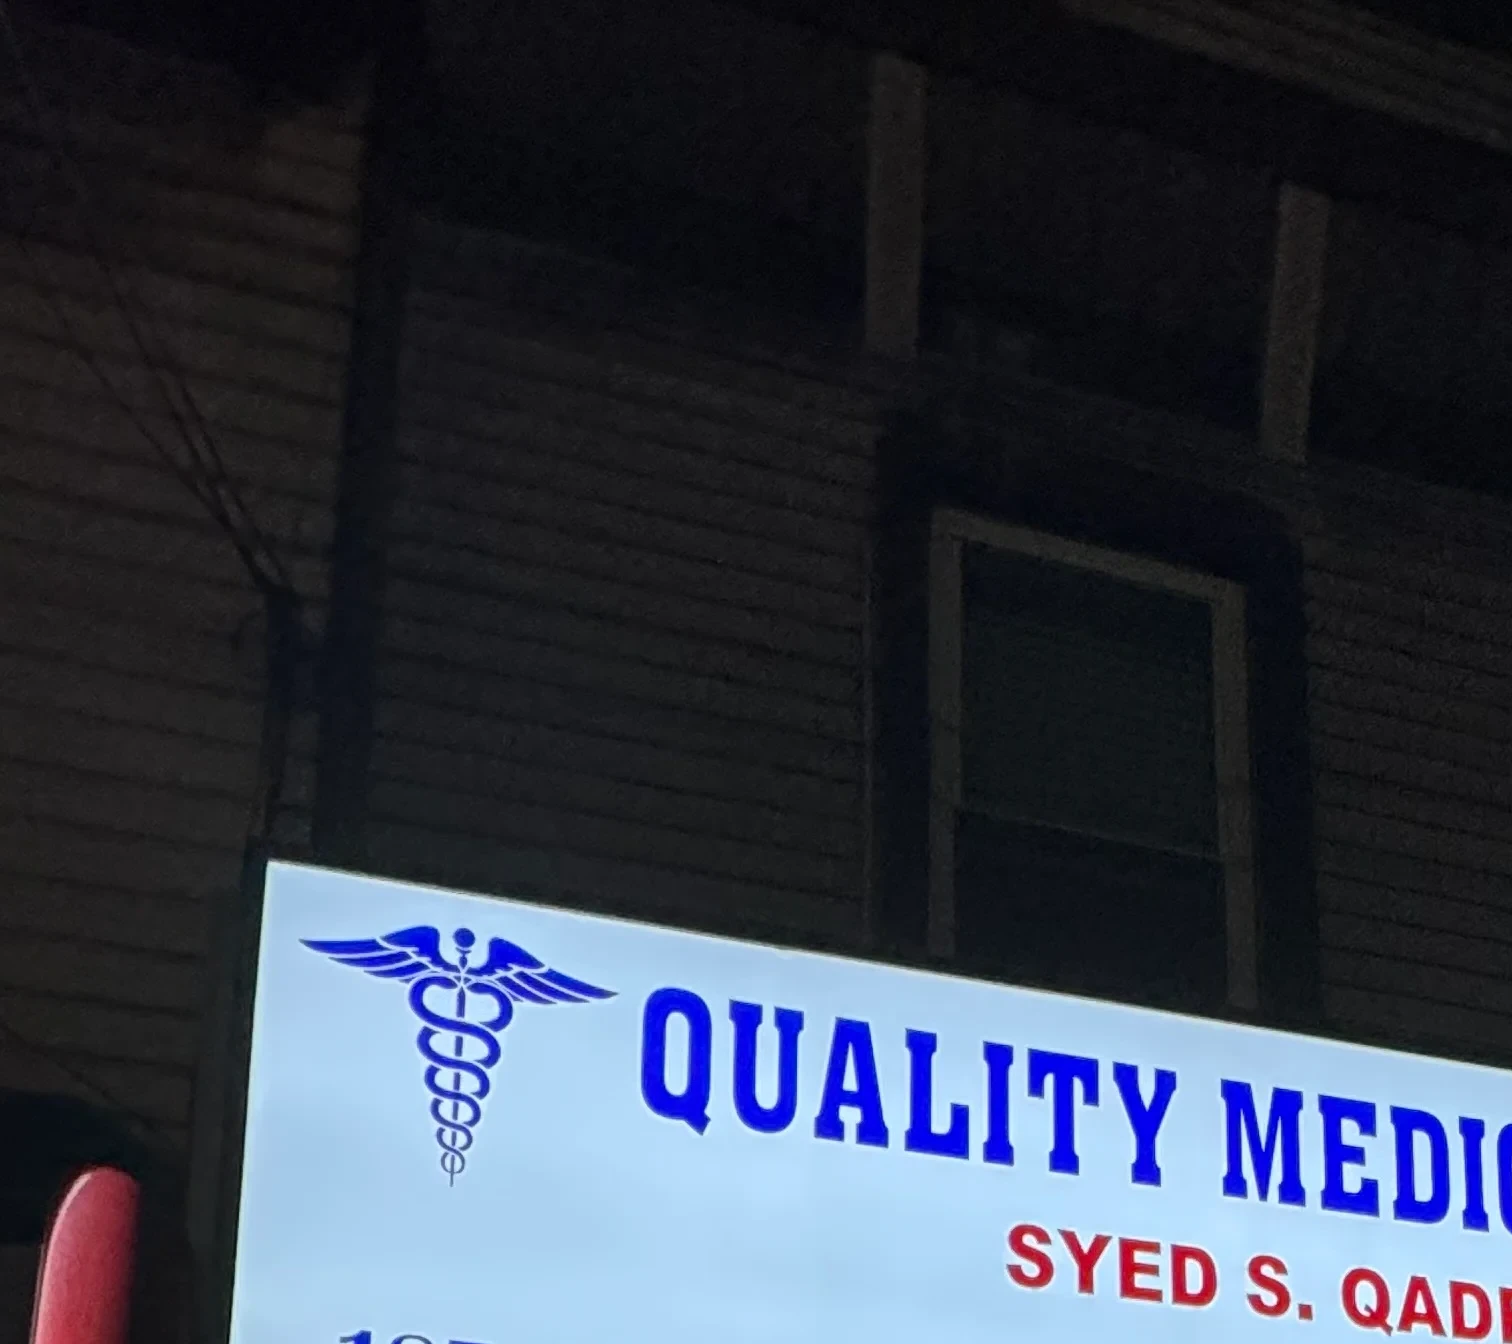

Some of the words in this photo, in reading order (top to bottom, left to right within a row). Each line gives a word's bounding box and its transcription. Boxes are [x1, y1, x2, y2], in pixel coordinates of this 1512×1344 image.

[641, 988, 1176, 1186] QUALITY
[1007, 1223, 1218, 1308] SYED
[1246, 1254, 1313, 1320] S.
